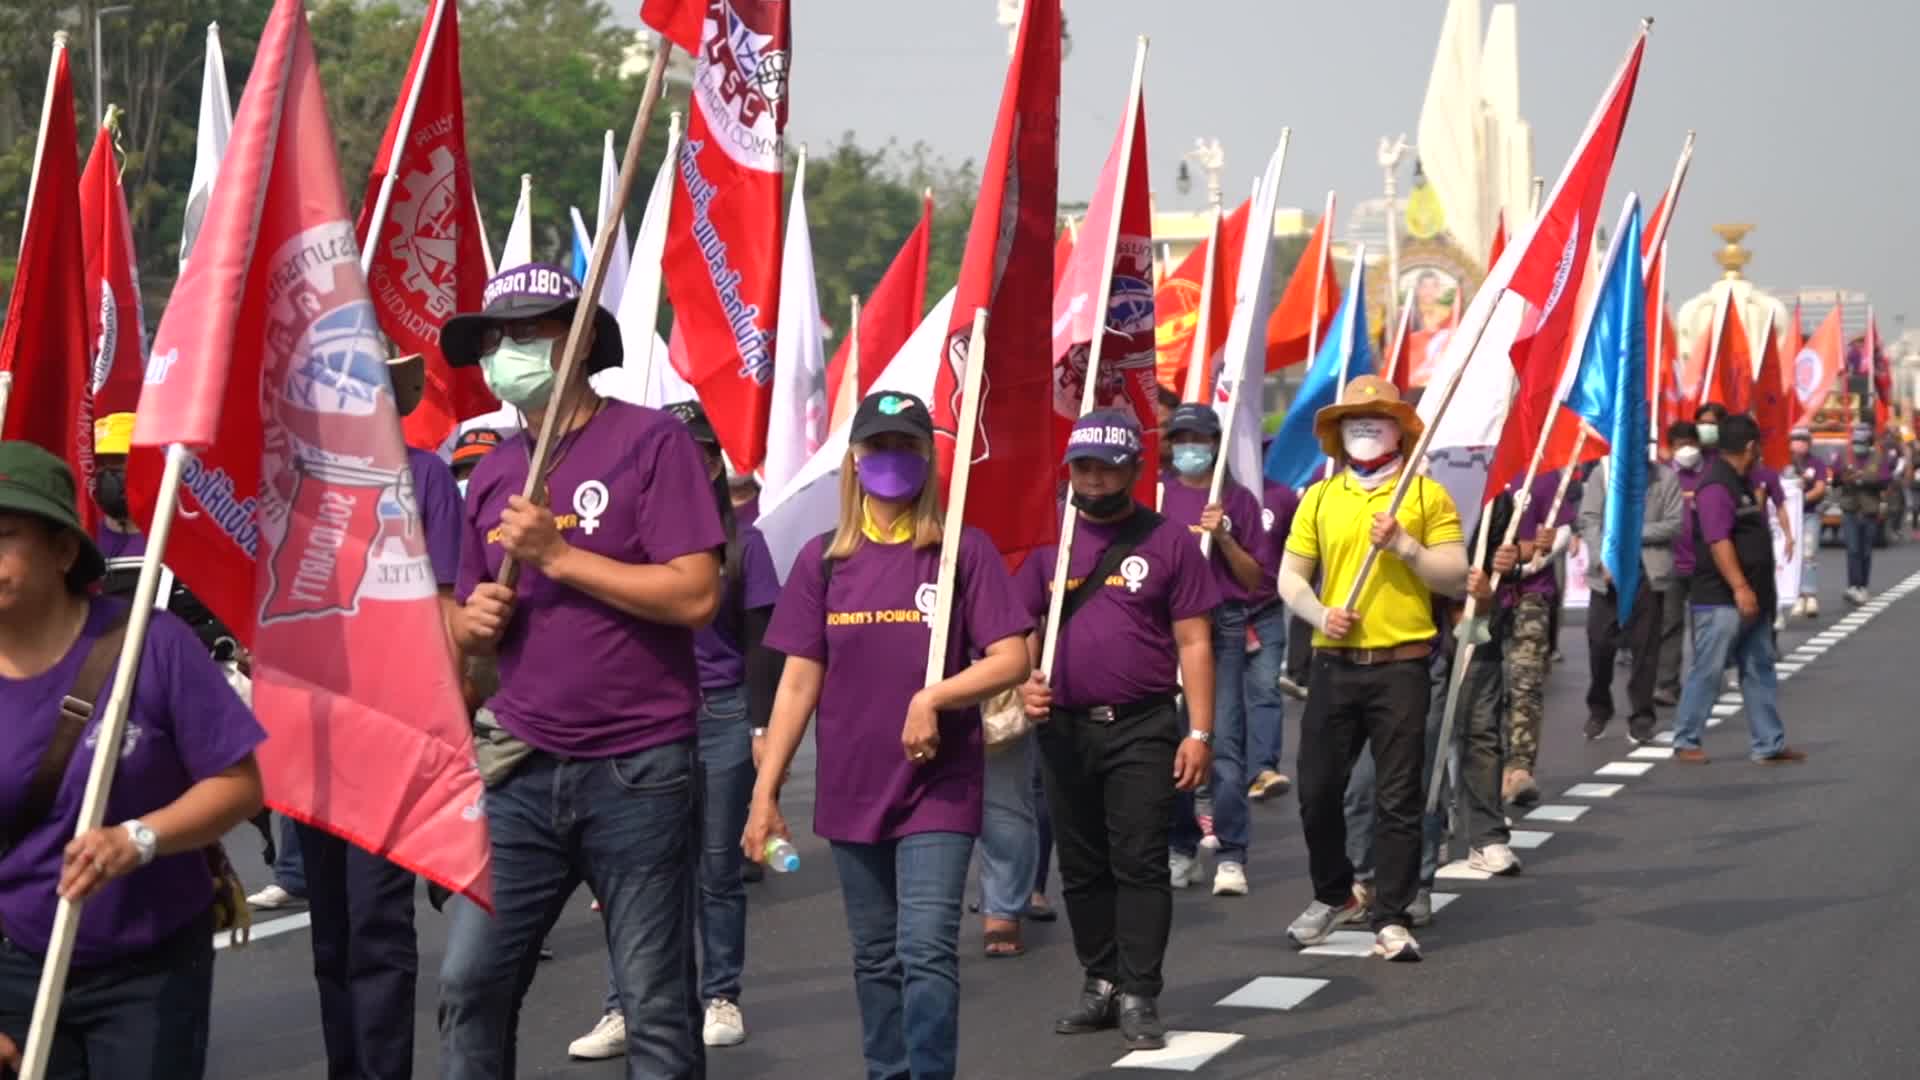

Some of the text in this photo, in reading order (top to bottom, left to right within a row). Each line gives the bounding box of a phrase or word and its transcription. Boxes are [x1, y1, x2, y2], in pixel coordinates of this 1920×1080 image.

[528, 267, 561, 296] 180
[1104, 425, 1127, 446] 180
[875, 609, 921, 623] POWER
